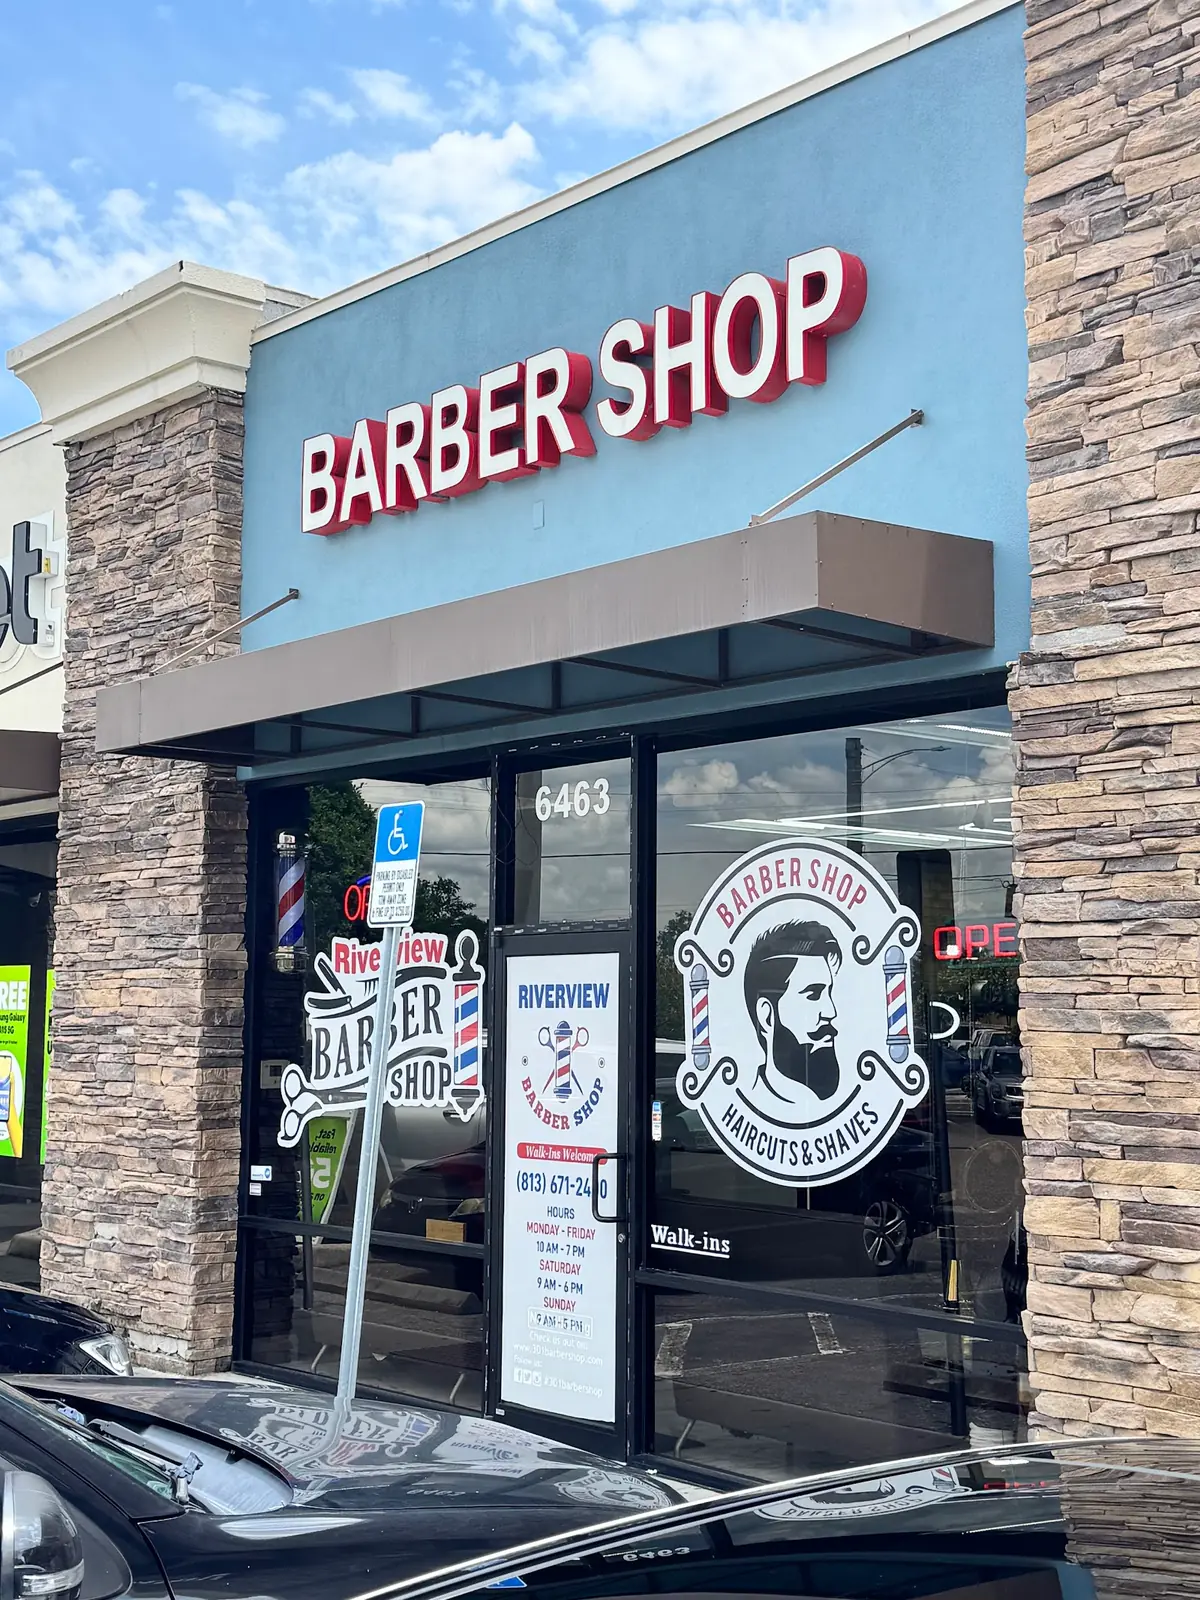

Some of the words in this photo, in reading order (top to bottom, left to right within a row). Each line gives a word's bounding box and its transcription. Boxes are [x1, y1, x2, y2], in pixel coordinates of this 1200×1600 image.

[302, 346, 594, 535] BARBER
[596, 246, 864, 440] SHOP
[535, 778, 610, 821] 6463
[716, 857, 801, 929] BARBER
[807, 858, 867, 910] SHOP
[335, 933, 445, 975] Riveview
[933, 922, 1018, 961] OPE
[518, 983, 609, 1009] RIVERVIEW
[390, 1060, 451, 1101] SHOP
[521, 1076, 570, 1130] BARBER
[573, 1077, 604, 1127] SHOP
[721, 1103, 798, 1167] HAIRCUTS
[816, 1101, 879, 1164] SHAVES
[525, 1145, 561, 1160] Walk-Ins
[516, 1170, 546, 1195] (813)
[550, 1174, 608, 1199] 671-240
[547, 1206, 575, 1220] HOURS
[526, 1221, 560, 1236] MONDAY
[567, 1226, 596, 1240] FRIDAY
[650, 1224, 730, 1255] Walk-ins
[536, 1241, 544, 1253] 10
[546, 1243, 559, 1254] AM
[566, 1244, 571, 1256] 7
[572, 1245, 585, 1258] PM
[539, 1258, 581, 1276] SATURDAY
[537, 1277, 542, 1289] 9
[543, 1278, 557, 1291] AM
[563, 1281, 569, 1293] 6
[570, 1282, 583, 1295] PM
[543, 1296, 576, 1312] SUNDAY
[536, 1313, 542, 1326] 9
[543, 1315, 556, 1328] AM
[563, 1318, 569, 1330] 5
[570, 1319, 583, 1333] PM
[513, 1343, 604, 1367] www.301barbershop.com
